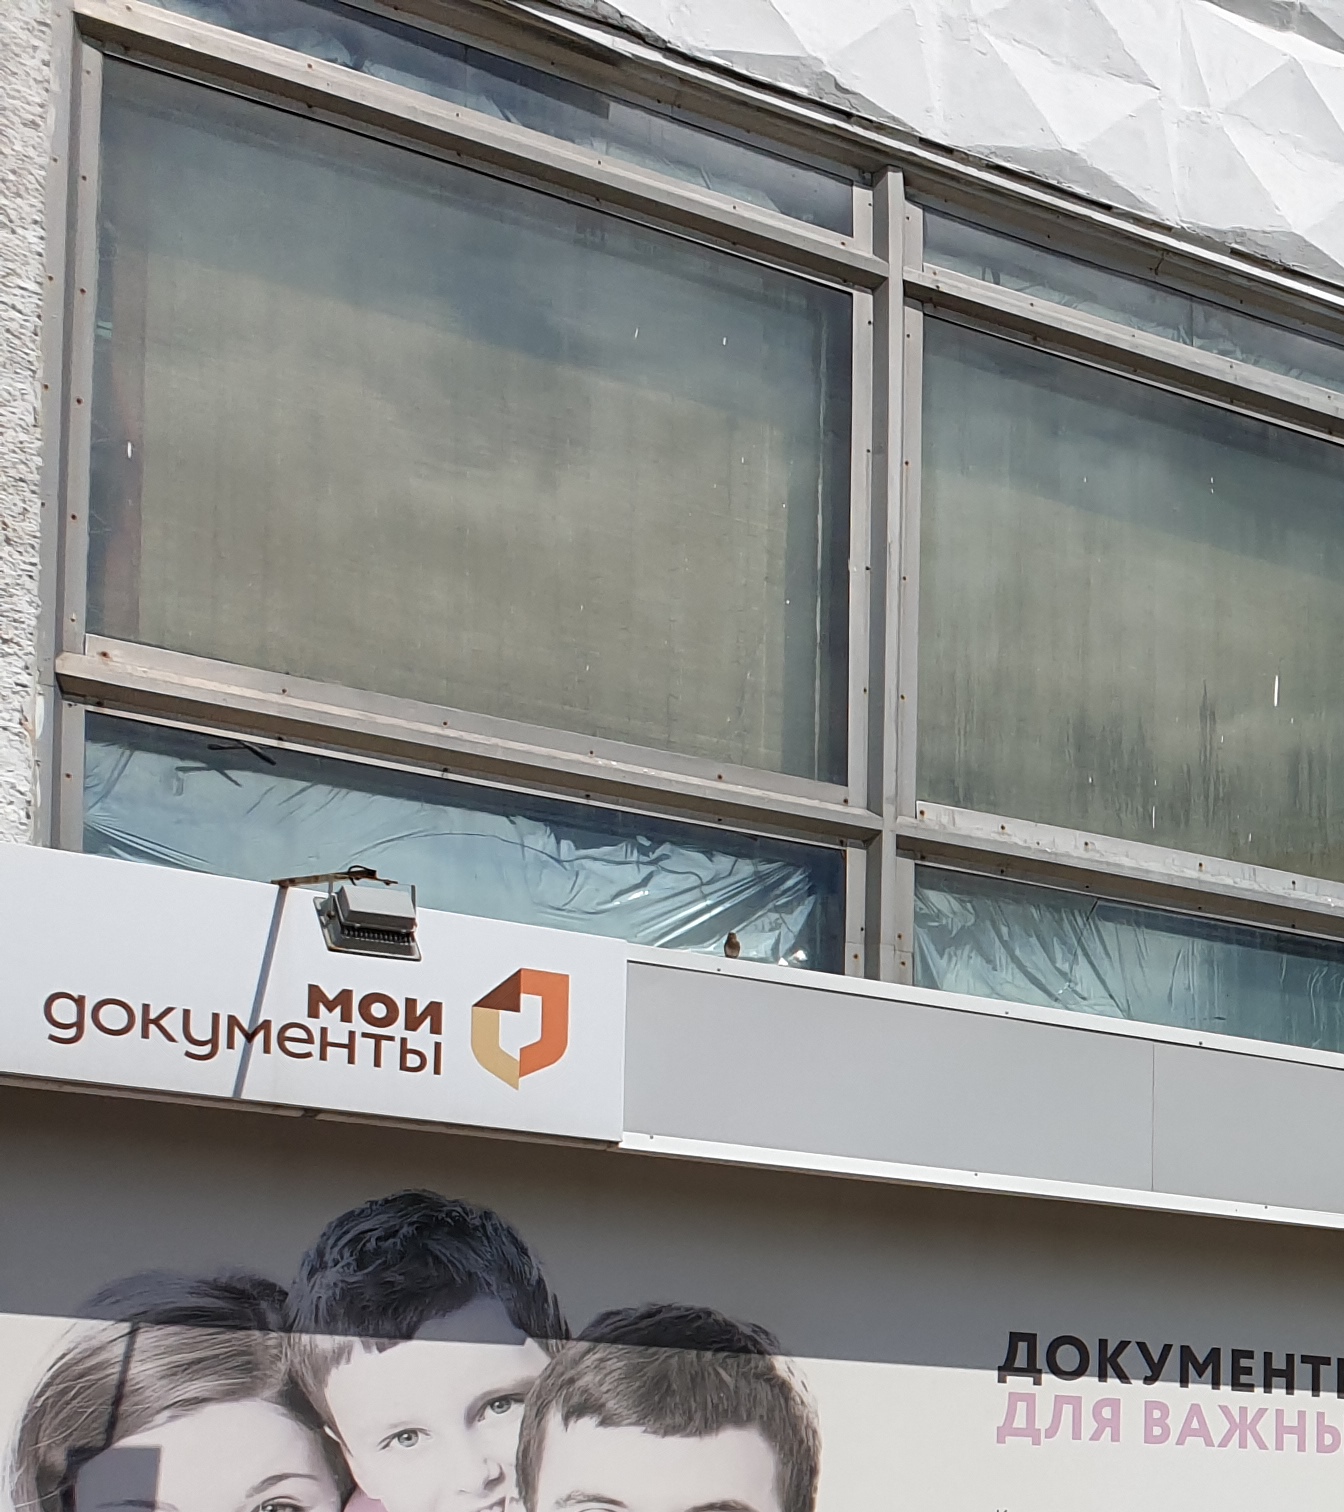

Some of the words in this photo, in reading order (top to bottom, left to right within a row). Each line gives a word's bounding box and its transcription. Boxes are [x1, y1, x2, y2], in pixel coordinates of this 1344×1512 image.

[43, 990, 443, 1076] документы
[307, 983, 443, 1036] мои
[996, 1391, 1122, 1447] ДЛЯ
